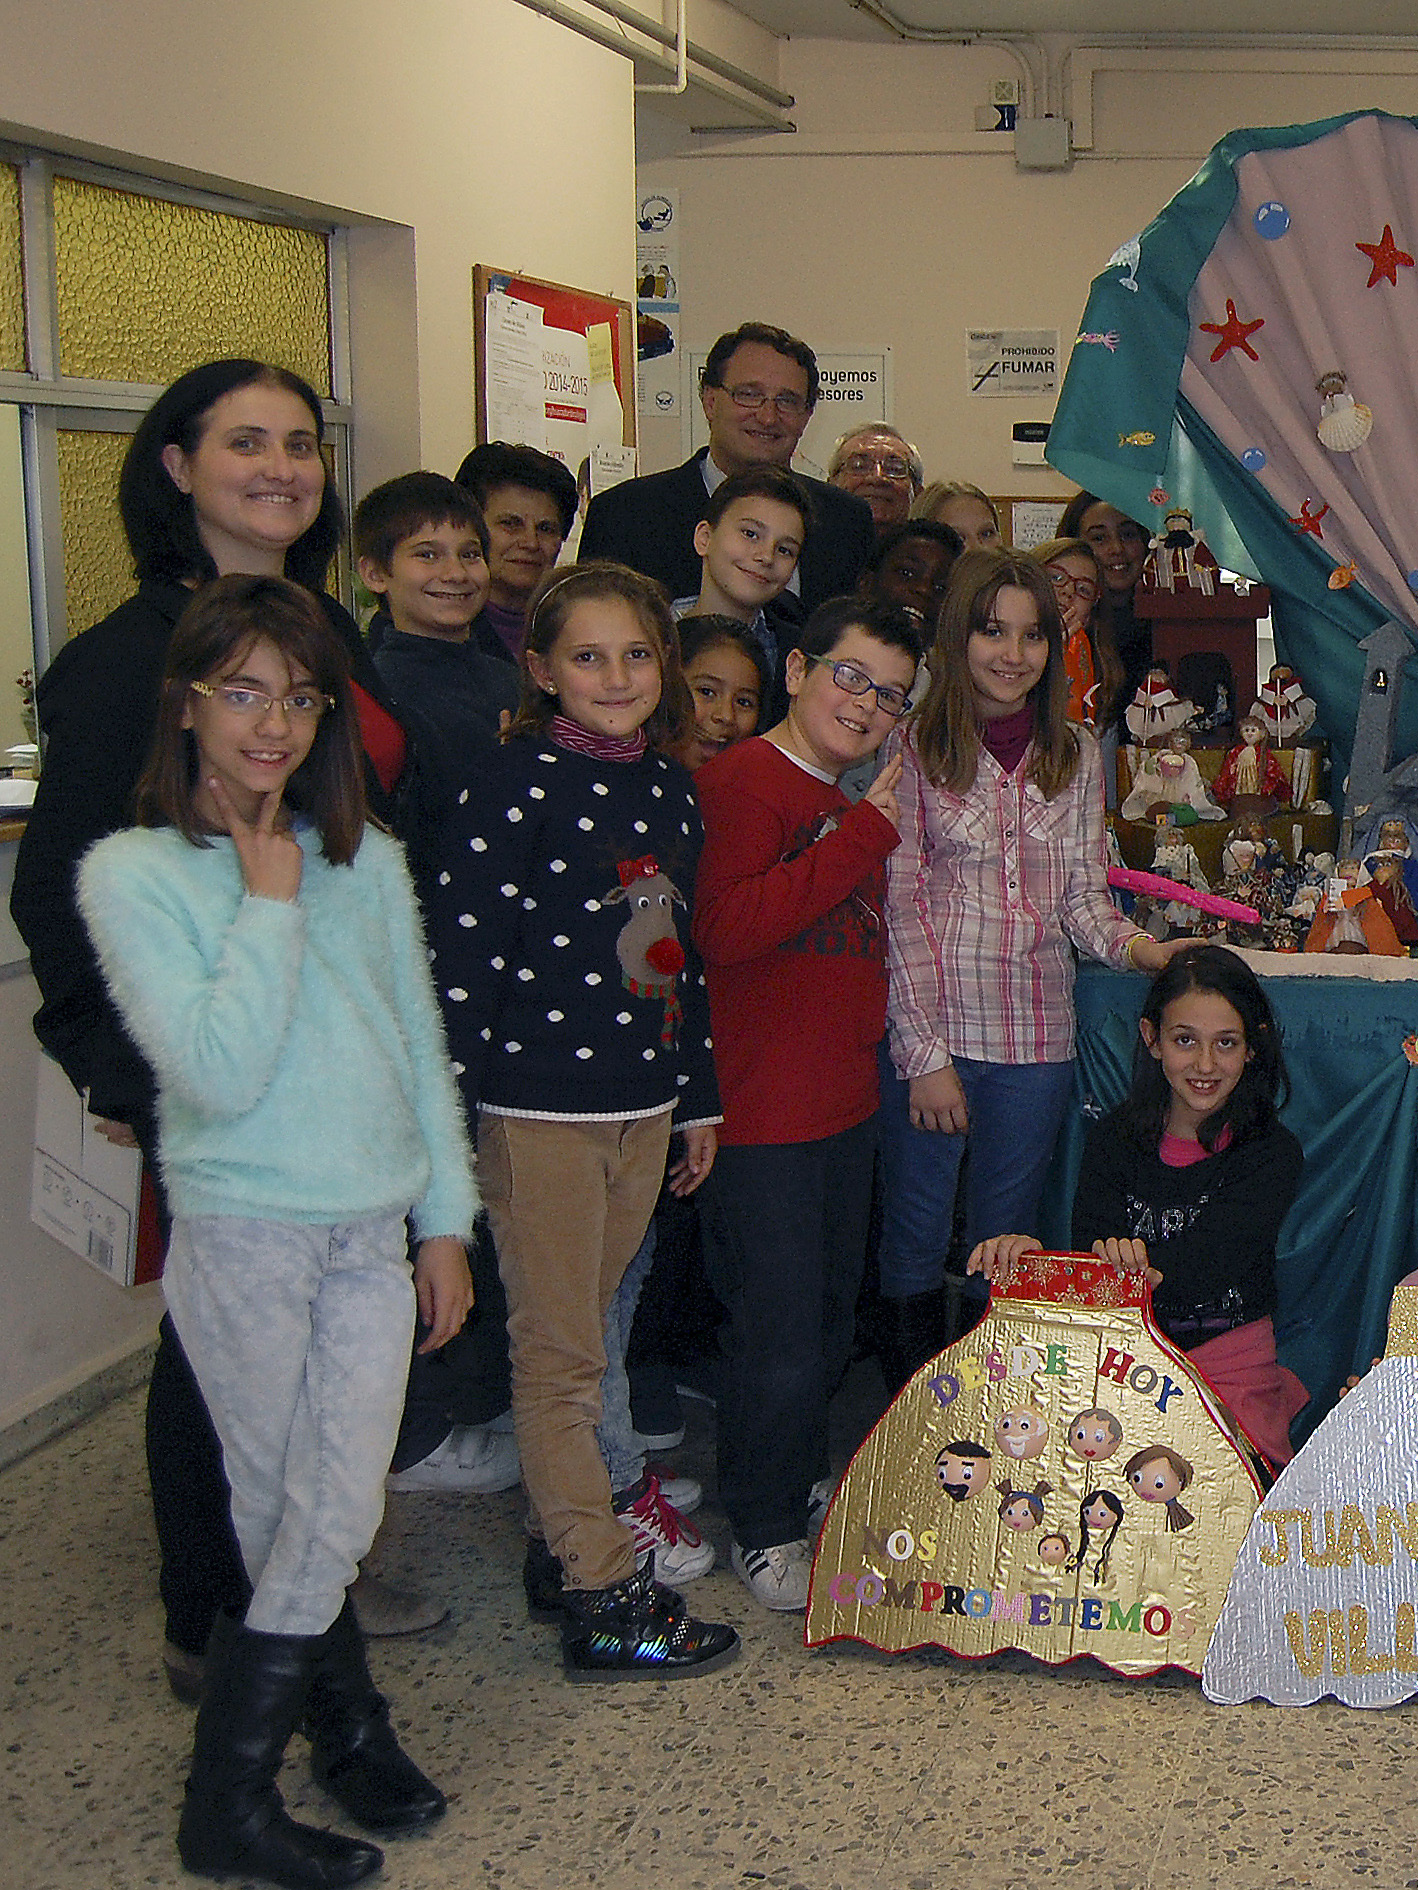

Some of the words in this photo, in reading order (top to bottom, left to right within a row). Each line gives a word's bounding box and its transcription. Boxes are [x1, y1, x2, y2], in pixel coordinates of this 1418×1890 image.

[819, 371, 877, 384] oyemos
[1002, 361, 1055, 373] FUMAR
[549, 371, 588, 396] 2014-2015
[818, 388, 864, 401] esores
[927, 1344, 1069, 1408] DESDE
[1100, 1347, 1184, 1413] HOY
[863, 1525, 938, 1561] NOS
[829, 1573, 1198, 1640] COMPROMETEMOS
